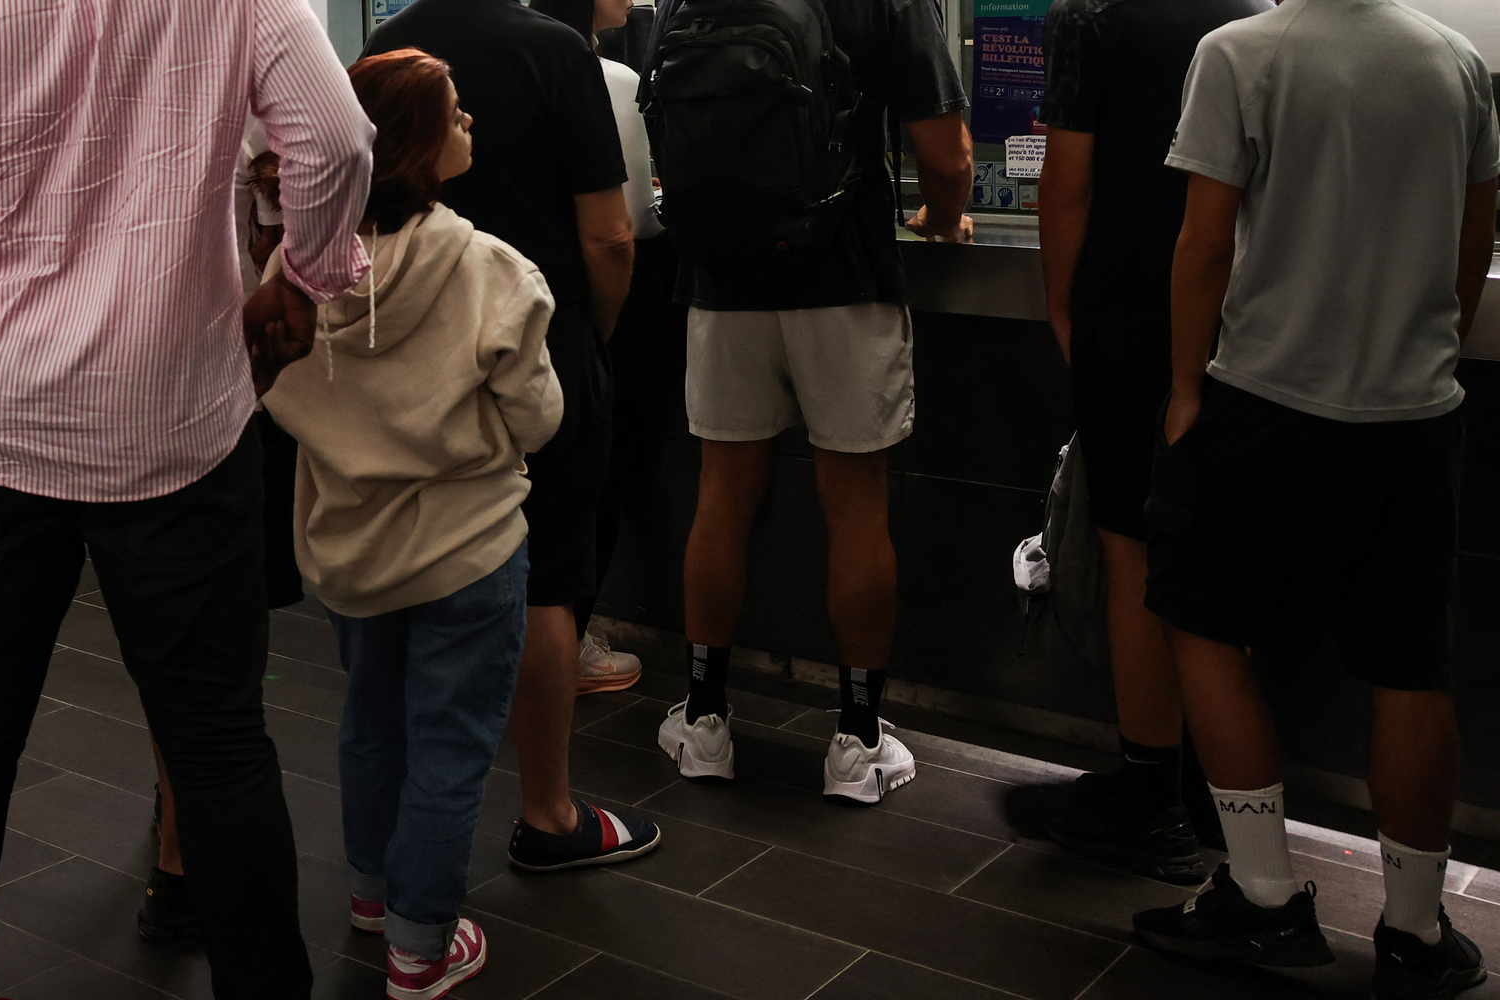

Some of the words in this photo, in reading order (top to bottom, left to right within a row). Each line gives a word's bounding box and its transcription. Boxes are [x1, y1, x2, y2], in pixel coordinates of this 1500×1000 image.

[980, 3, 1029, 11] Information
[982, 34, 1012, 43] C'EST
[1014, 35, 1030, 44] LA
[692, 659, 707, 682] NIKE
[851, 683, 869, 706] NIKE
[1218, 799, 1276, 815] MAN
